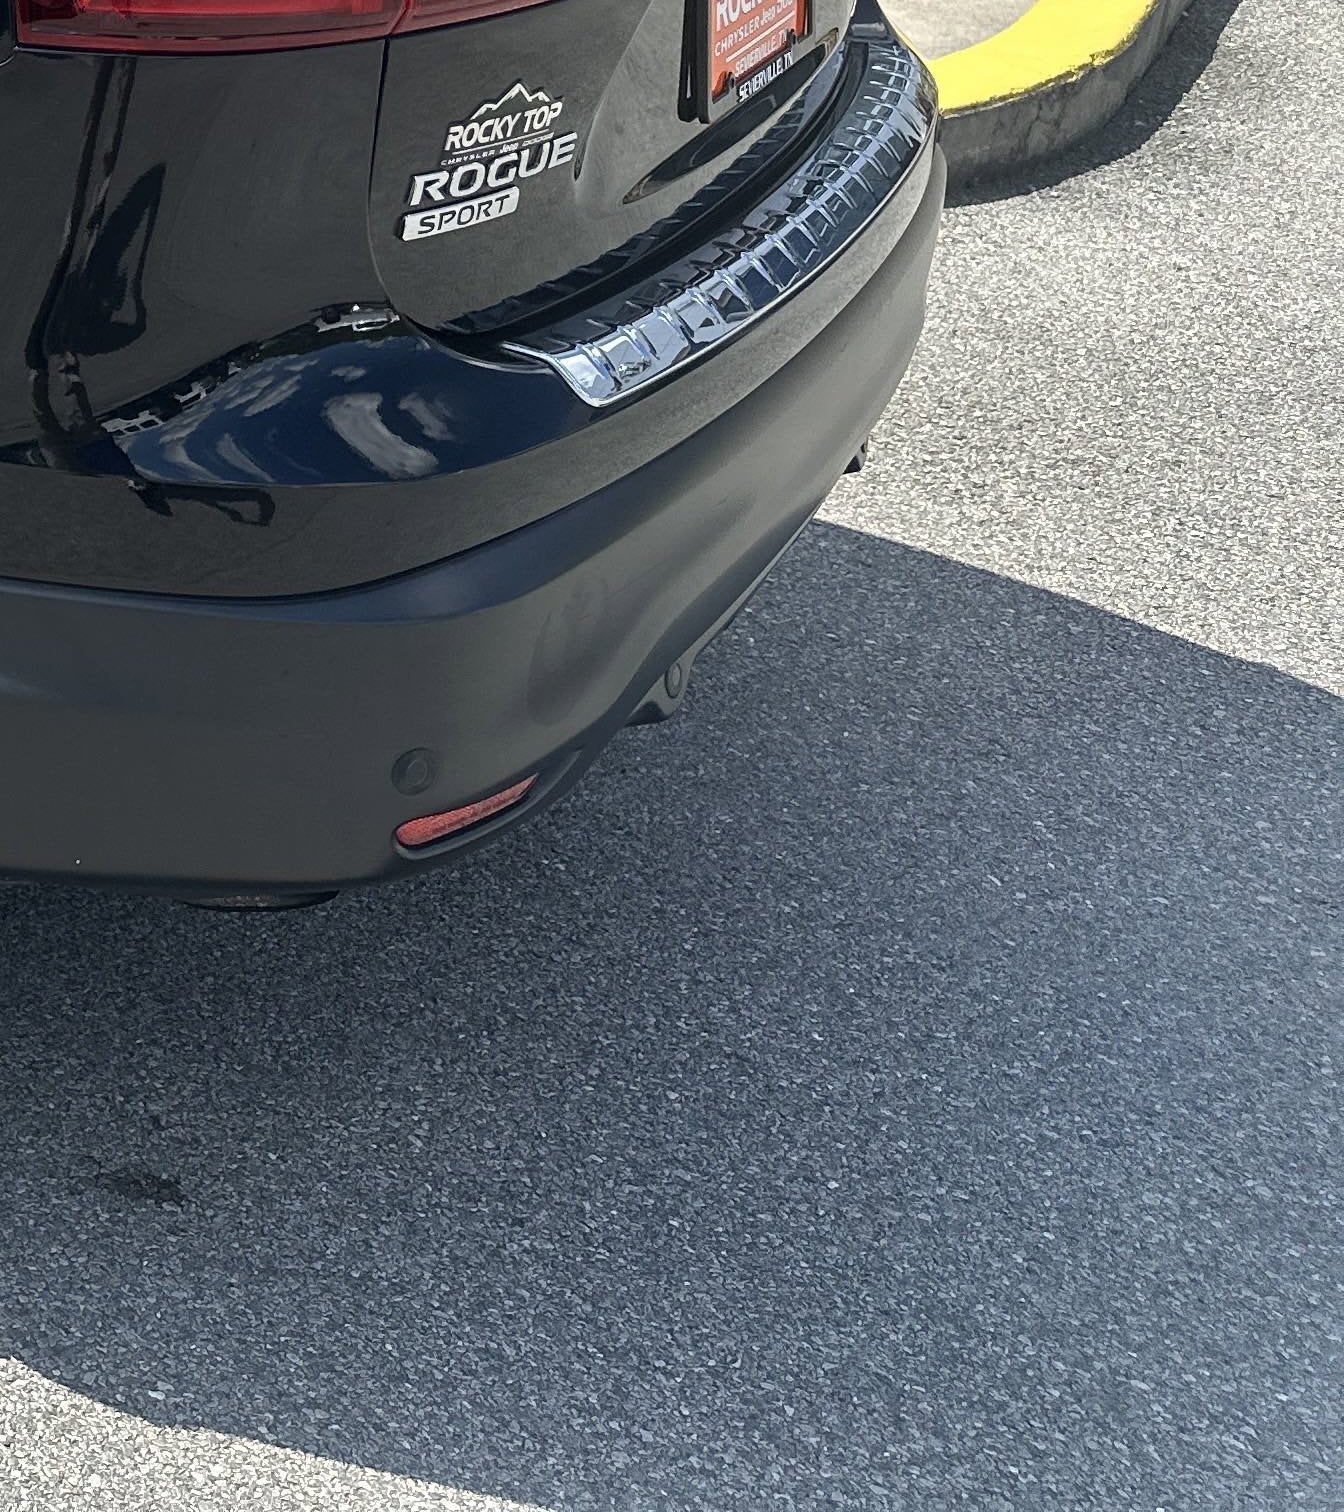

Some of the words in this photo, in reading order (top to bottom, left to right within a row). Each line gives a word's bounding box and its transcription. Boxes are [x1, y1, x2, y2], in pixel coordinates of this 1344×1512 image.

[715, 15, 760, 56] CHRYSLER
[444, 112, 522, 151] ROCKY
[523, 101, 563, 133] TOP
[410, 132, 577, 206] ROGUE
[440, 149, 495, 166] CHRYSLER
[499, 142, 519, 154] Jeep
[417, 194, 510, 235] SPORT
